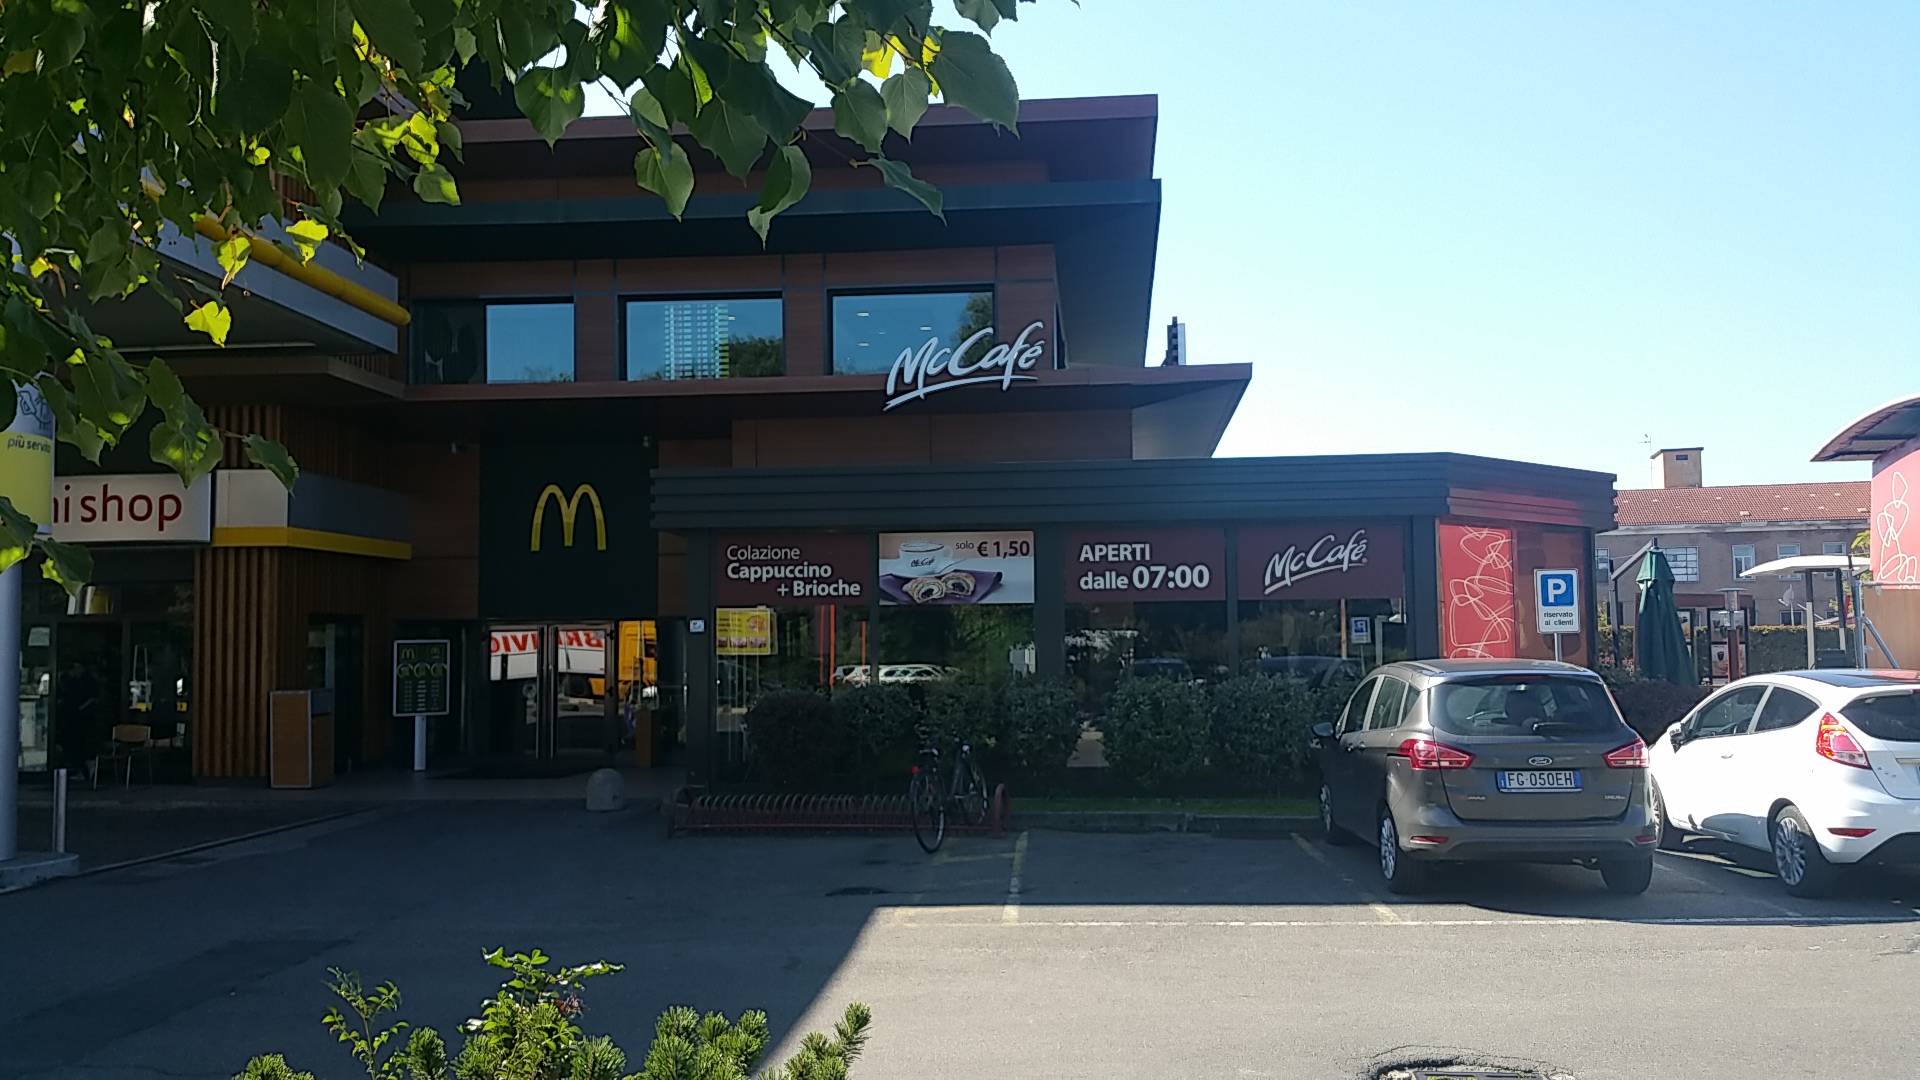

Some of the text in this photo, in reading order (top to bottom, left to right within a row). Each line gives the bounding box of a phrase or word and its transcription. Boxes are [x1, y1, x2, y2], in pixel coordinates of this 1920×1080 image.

[884, 321, 1046, 405] McCafé
[80, 484, 182, 532] shop
[726, 544, 801, 560] Colazione
[955, 540, 975, 550] solo
[993, 540, 1031, 559] 1,50
[1079, 543, 1151, 562] APERTI
[1264, 529, 1368, 592] McCafé
[727, 561, 832, 582] Cappuccino
[1079, 565, 1210, 590] dalle 07:00
[793, 579, 861, 597] Brioche
[1547, 578, 1567, 603] P
